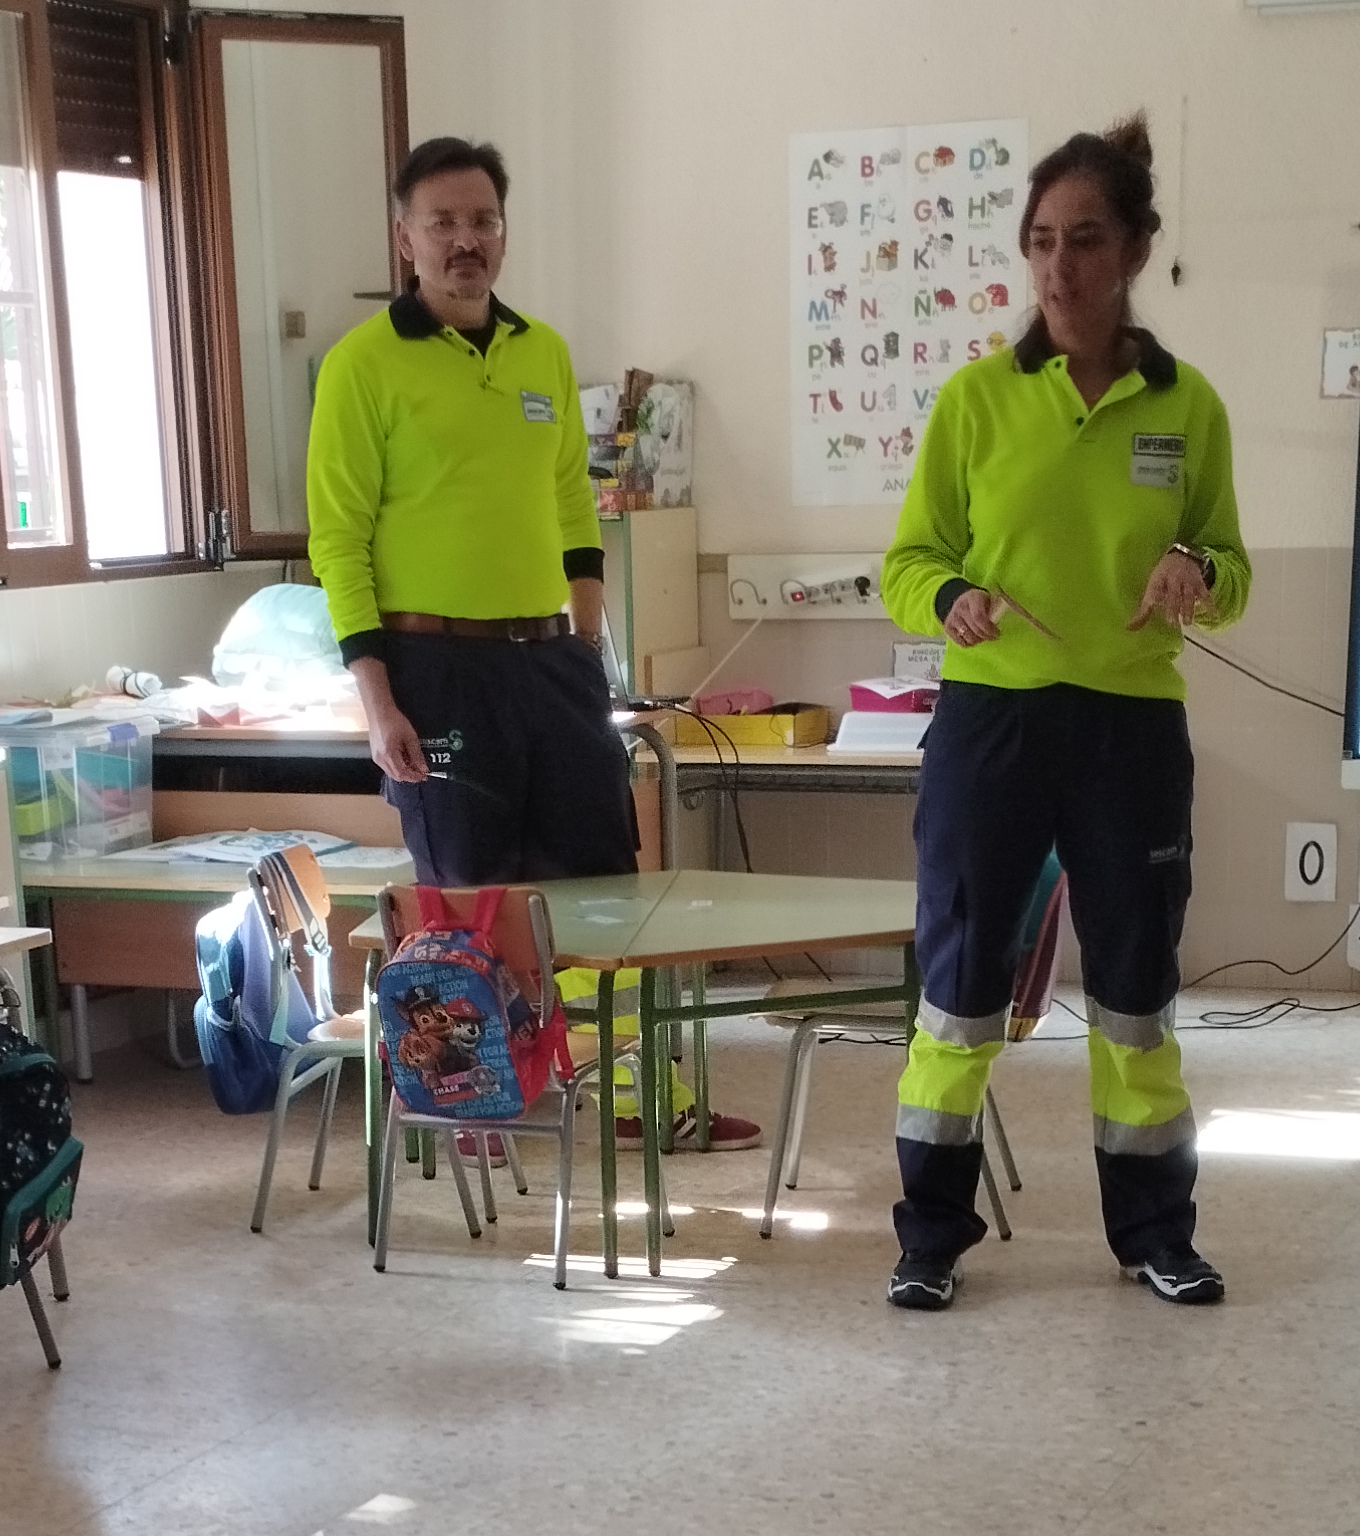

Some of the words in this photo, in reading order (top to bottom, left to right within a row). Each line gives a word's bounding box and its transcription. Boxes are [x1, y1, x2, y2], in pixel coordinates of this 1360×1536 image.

[807, 159, 824, 181] A
[860, 156, 874, 178] B
[914, 151, 931, 175] C
[969, 148, 986, 171] D
[807, 206, 819, 228] E
[860, 204, 872, 226] F
[914, 200, 932, 222] G
[968, 196, 986, 219] H
[807, 254, 813, 276] I
[860, 251, 871, 273] J
[914, 247, 929, 270] K
[968, 246, 980, 267] L
[808, 300, 830, 321] M
[860, 298, 877, 320] N
[914, 289, 931, 318] Ñ
[968, 292, 987, 315] O
[808, 345, 823, 368] P
[861, 344, 879, 367] Q
[913, 342, 928, 364] R
[967, 339, 982, 361] S
[809, 393, 821, 414] T
[860, 391, 877, 412] U
[913, 388, 929, 410] V
[826, 437, 842, 459] X
[878, 436, 892, 457] Y
[430, 752, 451, 763] 112
[1299, 841, 1324, 885] 0
